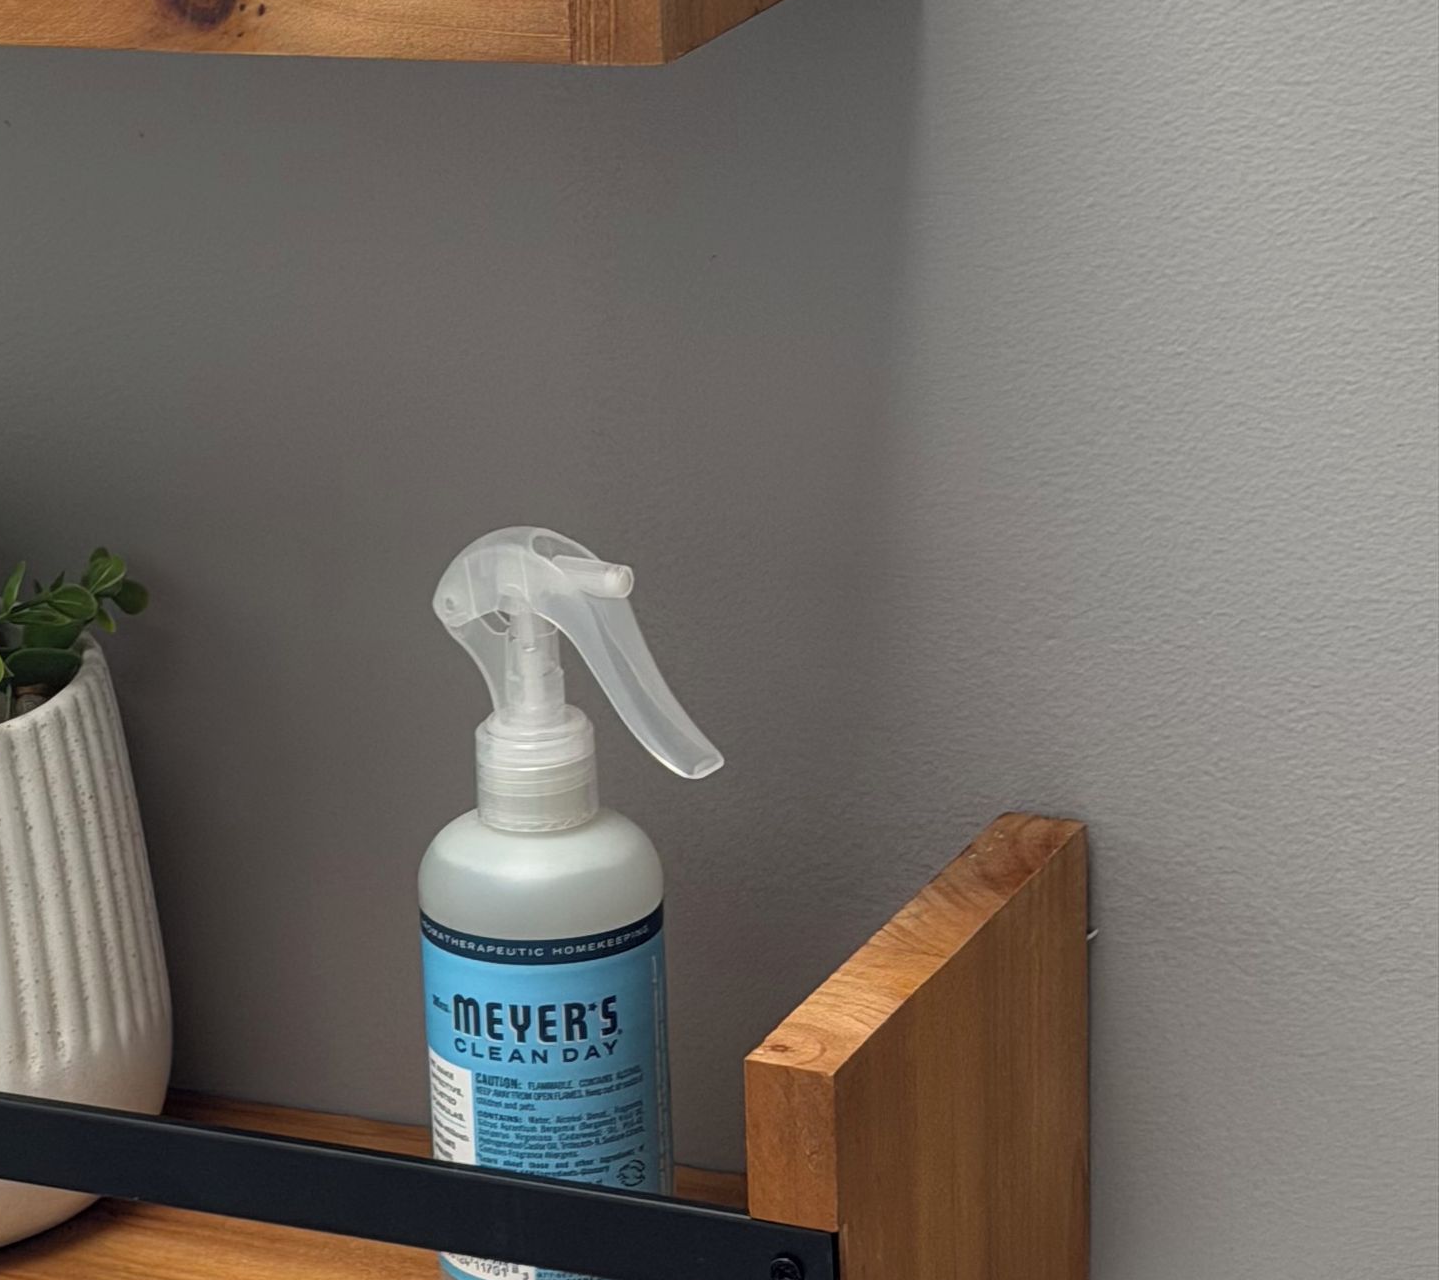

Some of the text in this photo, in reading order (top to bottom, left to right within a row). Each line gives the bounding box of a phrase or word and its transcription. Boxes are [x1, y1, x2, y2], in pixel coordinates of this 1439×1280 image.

[454, 1038, 619, 1064] CLEAN DAY
[475, 1072, 522, 1089] CAUTION:
